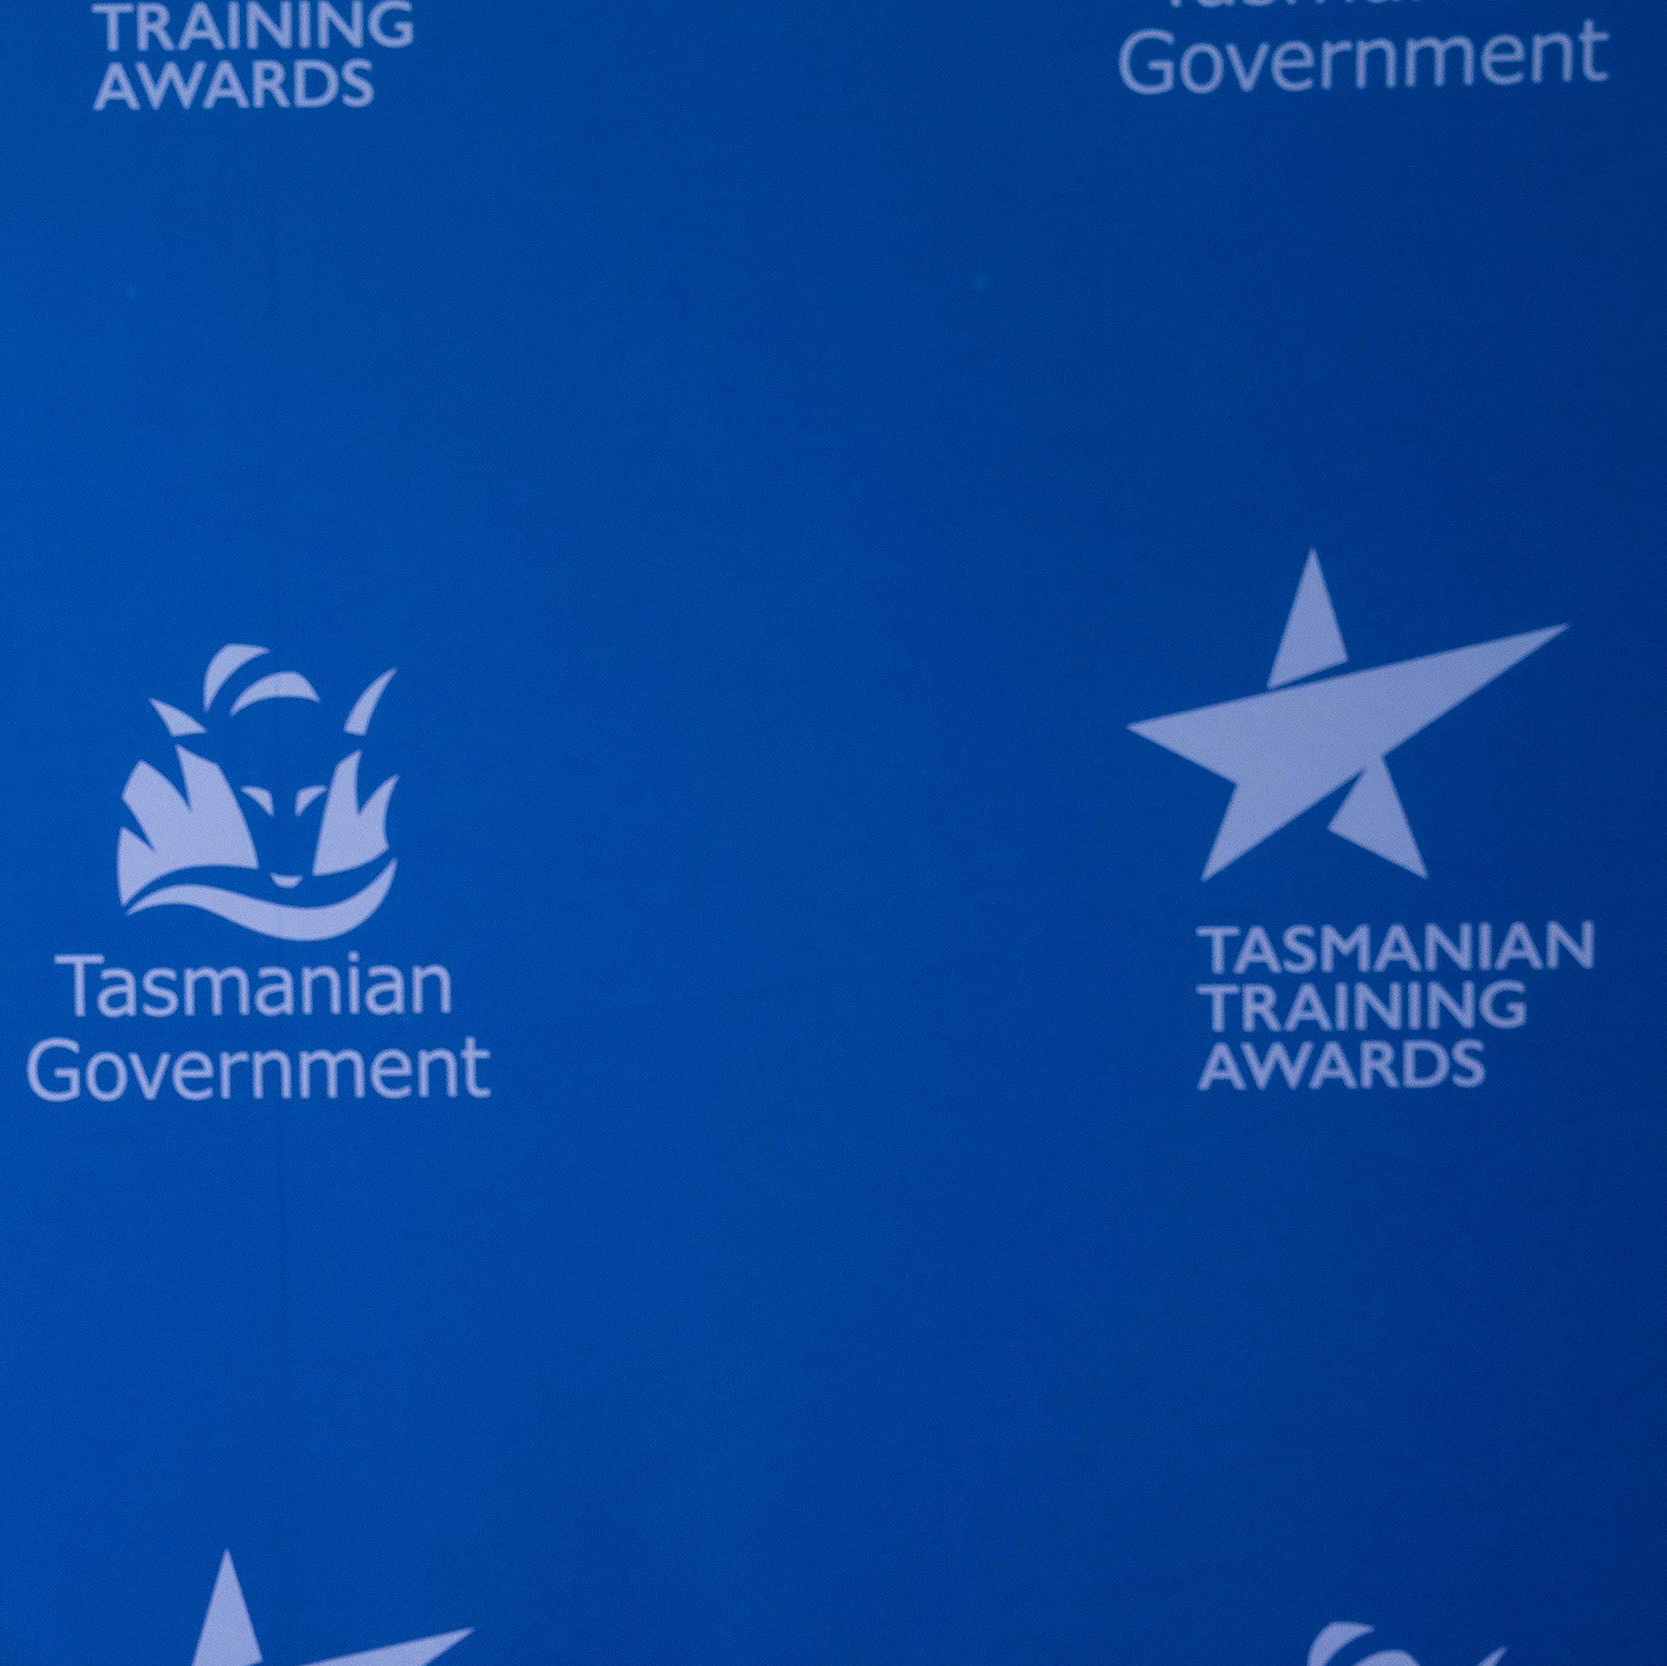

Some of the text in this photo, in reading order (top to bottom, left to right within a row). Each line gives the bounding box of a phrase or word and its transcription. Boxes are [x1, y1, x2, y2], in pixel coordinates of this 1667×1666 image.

[91, 0, 414, 52] TRAINING
[1118, 19, 1609, 95] Government
[93, 58, 374, 111] AWARDS
[1196, 920, 1594, 974] TASMANIAN
[54, 951, 451, 1018] Tasmanian
[1196, 980, 1526, 1032] TRAINING
[26, 1036, 491, 1102] Government
[1198, 1039, 1485, 1091] AWARDS
